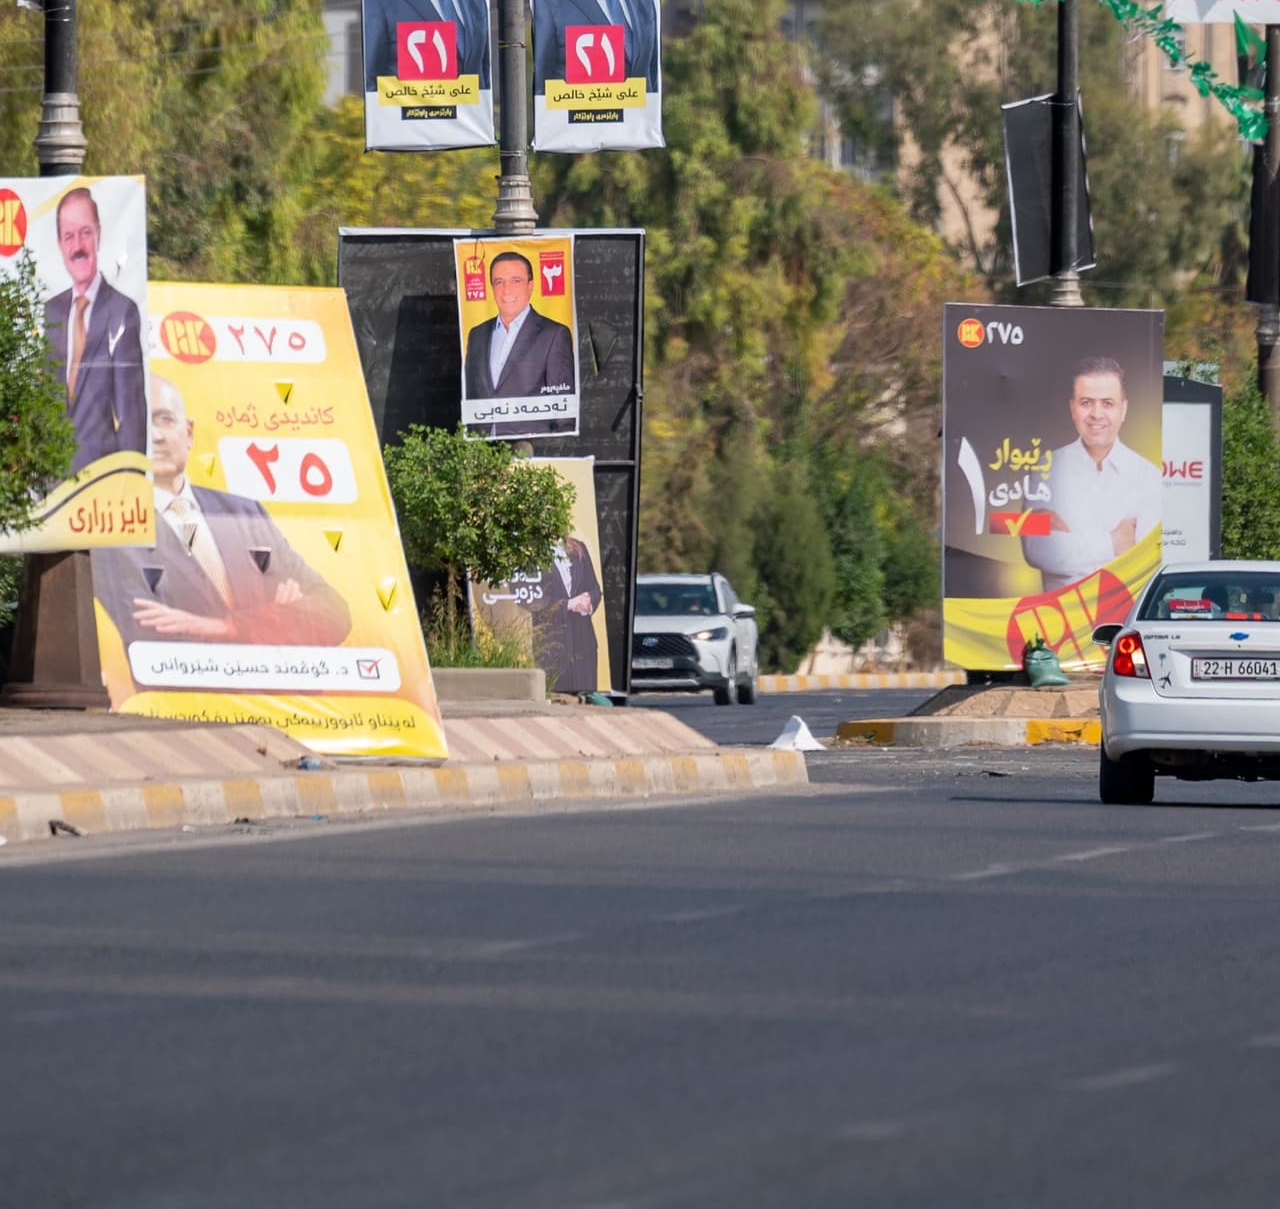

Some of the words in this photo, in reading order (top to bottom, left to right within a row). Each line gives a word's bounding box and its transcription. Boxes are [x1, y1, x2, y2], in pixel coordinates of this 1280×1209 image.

[406, 28, 449, 75] ٢١
[575, 32, 617, 78] ٢١
[541, 263, 563, 293] ٣
[227, 324, 307, 356] ٢٧٥
[986, 321, 1025, 346] ٢٧٥
[215, 402, 260, 429] ژمارە
[263, 405, 336, 432] کاندیدی
[474, 401, 510, 421] نەبی
[513, 397, 569, 415] ئەحمەد
[245, 441, 333, 497] ٢٥
[956, 436, 987, 536] ١
[987, 474, 1054, 508] هادی
[68, 498, 115, 535] زراری
[119, 497, 148, 535] بایز
[1238, 661, 1278, 676] 66041
